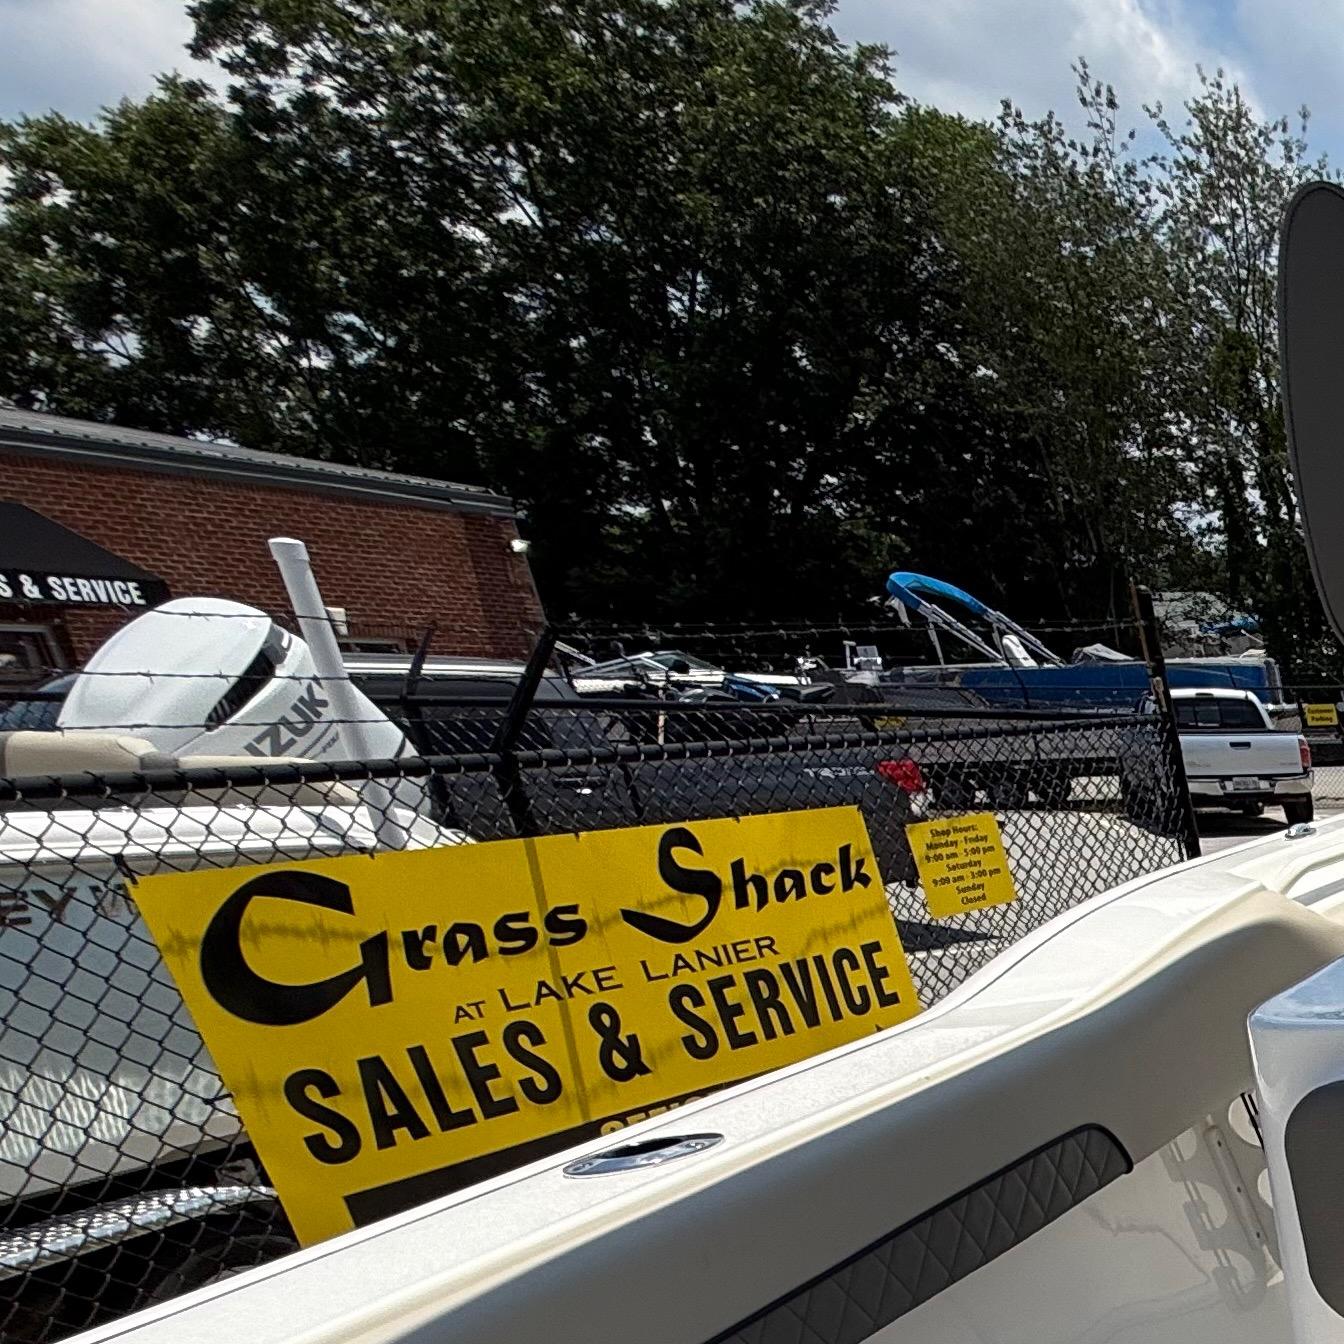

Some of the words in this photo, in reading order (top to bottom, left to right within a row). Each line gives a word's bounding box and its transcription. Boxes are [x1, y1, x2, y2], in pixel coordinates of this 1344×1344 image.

[18, 574, 44, 599] &
[46, 576, 147, 605] SERVICE
[930, 828, 951, 838] Shop
[925, 840, 958, 851] Monday
[964, 835, 988, 845] Friday
[925, 852, 944, 863] 9:00
[946, 851, 958, 860] am
[964, 847, 980, 857] 5:00
[982, 845, 995, 855] pm
[946, 859, 982, 872] Saturday
[952, 875, 965, 883] am
[988, 867, 1001, 877] pm
[956, 882, 985, 894] Sunday
[961, 893, 987, 905] Closed
[201, 870, 588, 1026] Grass
[620, 827, 872, 943] Shack
[454, 1001, 486, 1024] AT
[498, 966, 624, 1012] LAKE
[641, 936, 780, 983] LANIER
[284, 1020, 562, 1164] SALES
[588, 1002, 653, 1083] &
[669, 941, 900, 1060] SERVICE
